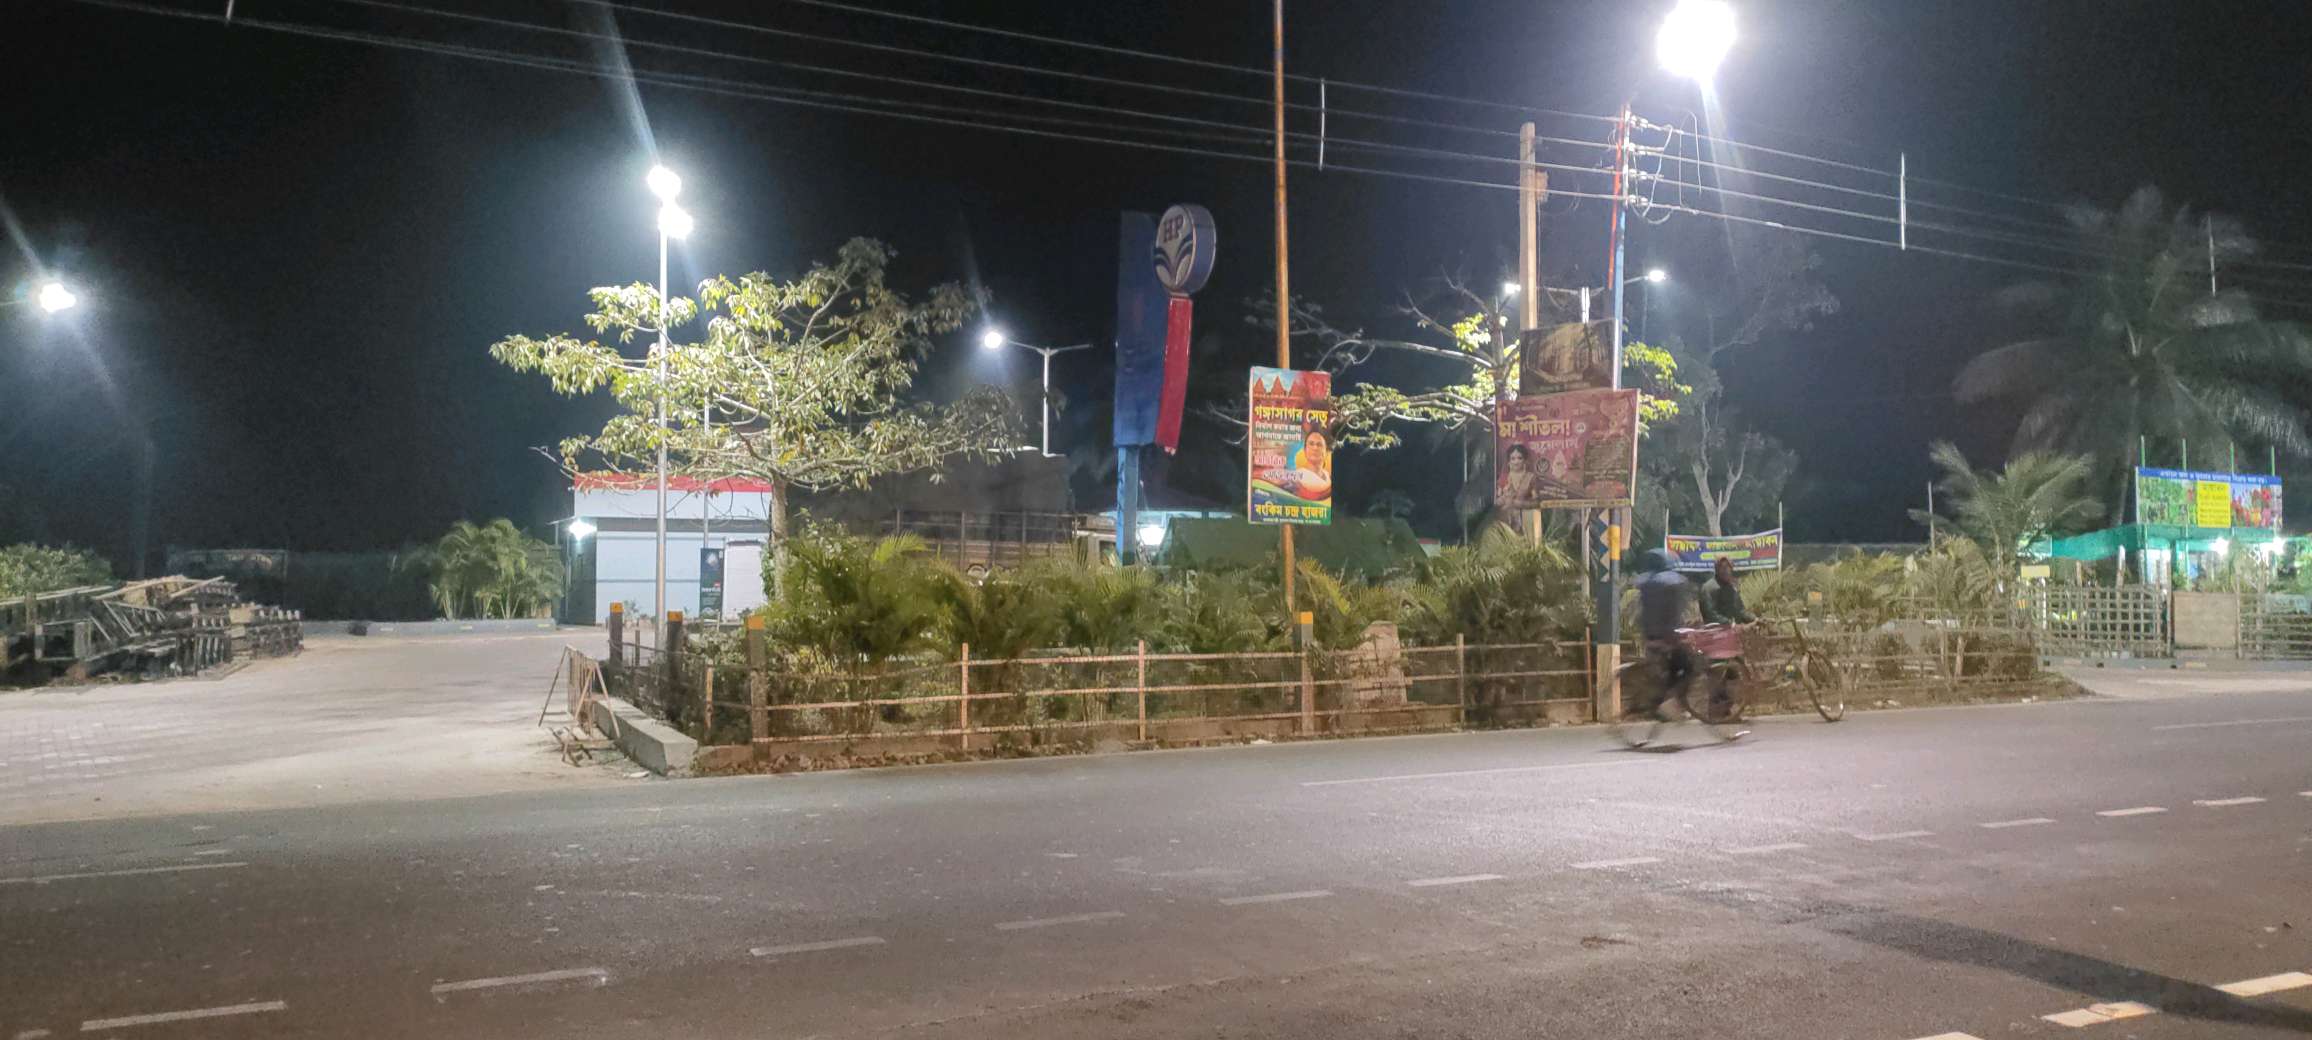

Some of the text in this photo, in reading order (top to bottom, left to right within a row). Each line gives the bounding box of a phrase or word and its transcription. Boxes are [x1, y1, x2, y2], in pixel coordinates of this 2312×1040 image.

[1163, 214, 1184, 243] HP
[1254, 404, 1329, 428] গঙ্গাসাগর সেতু
